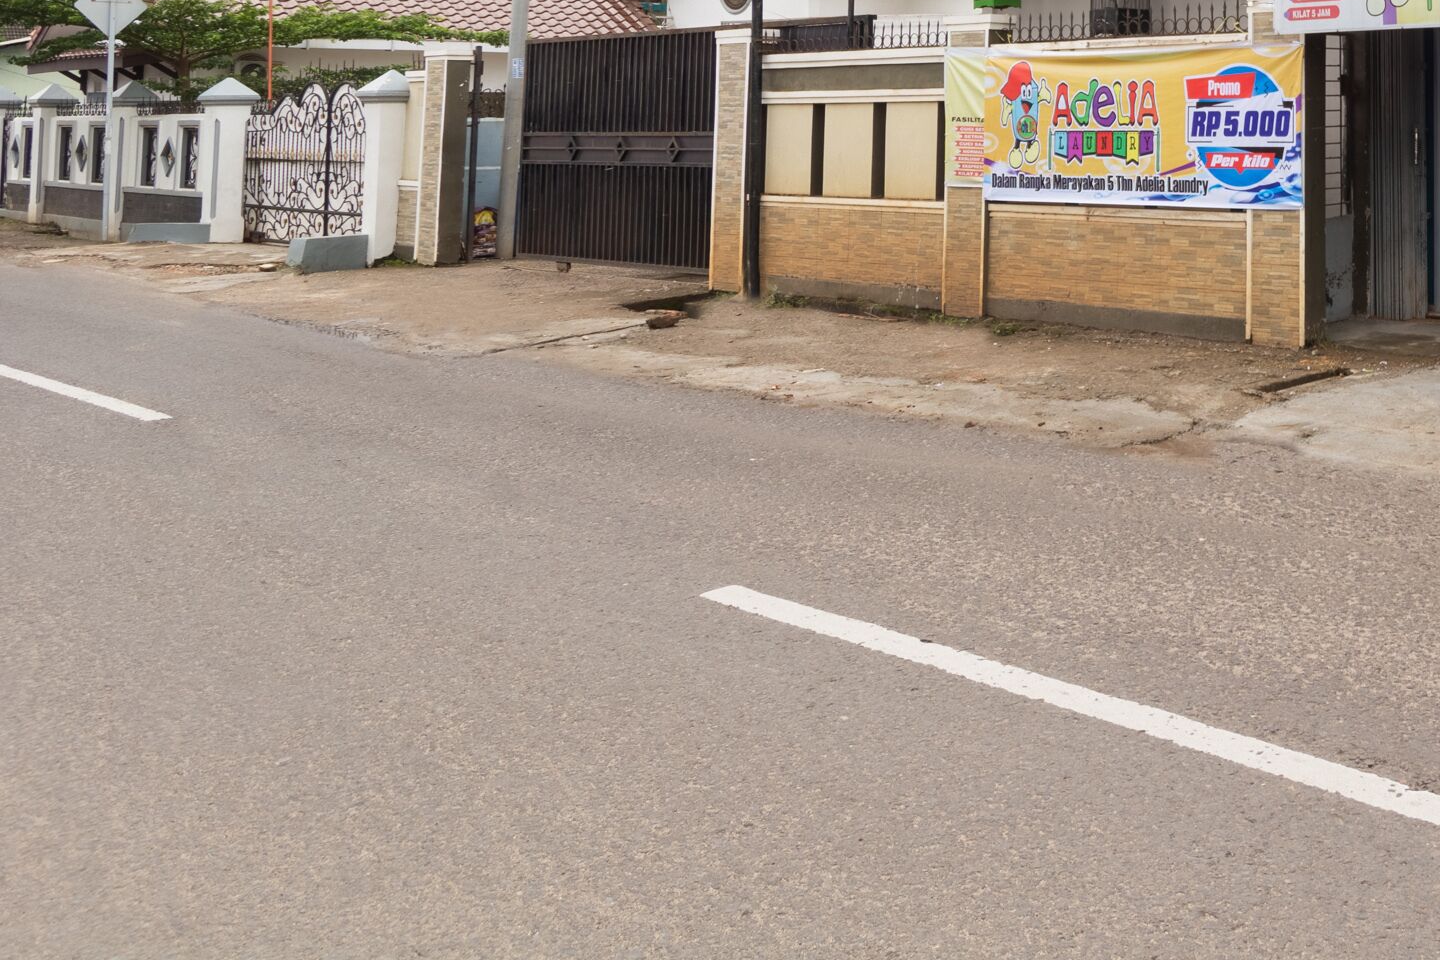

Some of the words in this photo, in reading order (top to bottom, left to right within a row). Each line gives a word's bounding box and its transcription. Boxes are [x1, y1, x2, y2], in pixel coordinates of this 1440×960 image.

[1292, 10, 1310, 18] KILAT
[1317, 8, 1331, 17] JAM
[1208, 80, 1240, 96] Promo
[1191, 111, 1221, 137] RP.
[1224, 110, 1291, 137] 5.000
[1057, 134, 1152, 153] LAUNDRY
[1210, 154, 1240, 167] Per
[1242, 154, 1270, 167] kilo
[992, 173, 1017, 188] Dalam
[1018, 174, 1050, 191] Rangka
[1053, 174, 1105, 192] Merayakan
[1107, 175, 1114, 190] 5
[1116, 176, 1133, 192] Thn
[1135, 176, 1165, 193] Adelia
[1167, 176, 1209, 196] Laundry
